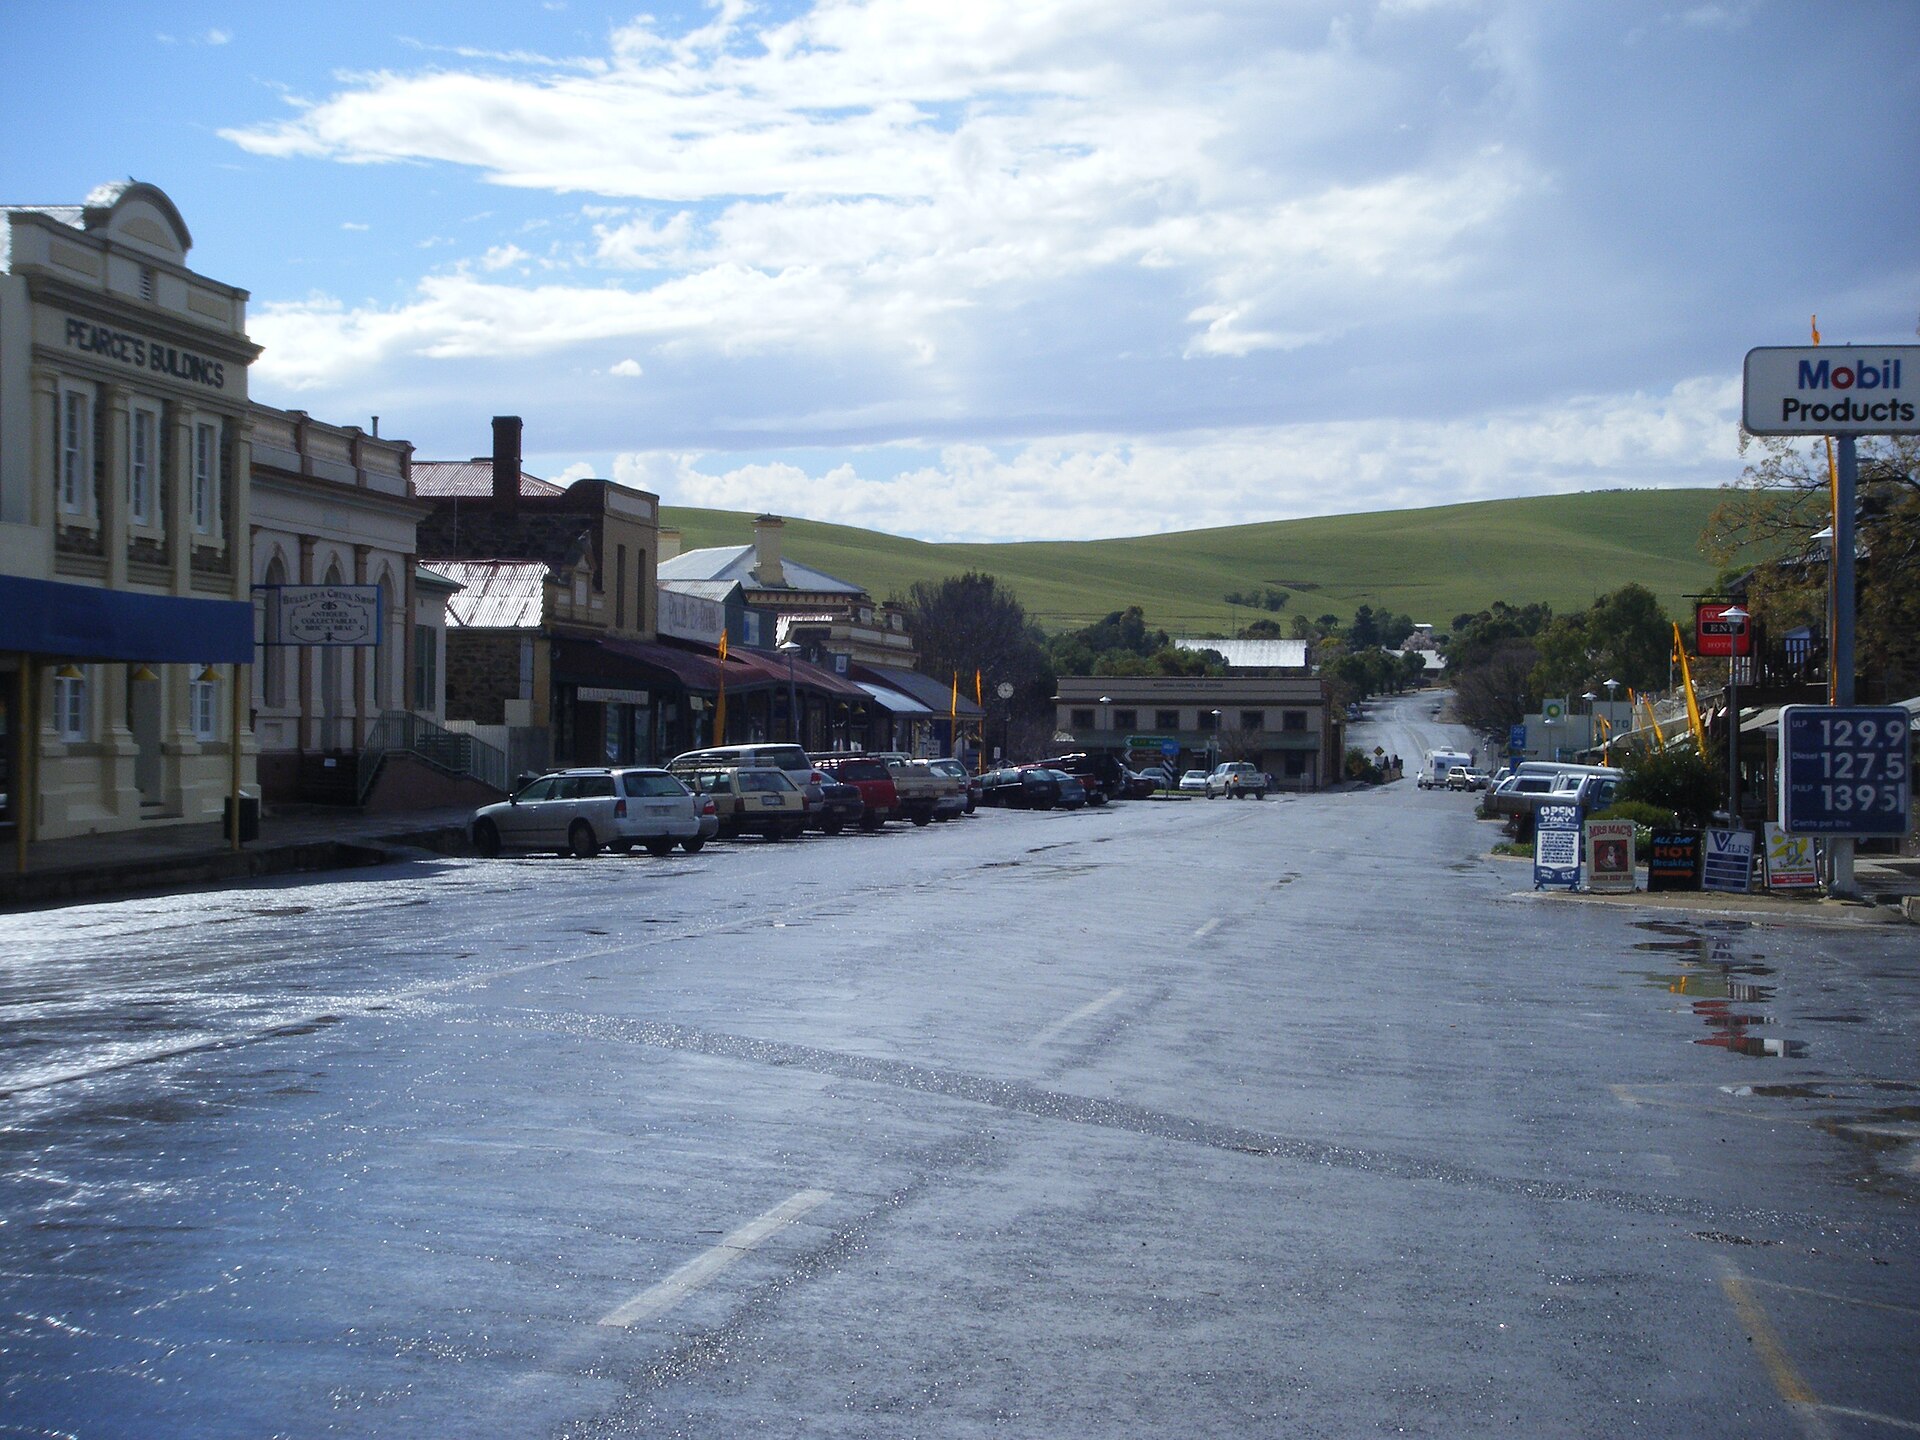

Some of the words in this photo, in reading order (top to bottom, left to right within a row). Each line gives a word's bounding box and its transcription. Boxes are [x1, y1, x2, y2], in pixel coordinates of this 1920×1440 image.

[65, 318, 146, 368] PEARCE'S
[1798, 359, 1901, 390] Mobil
[1782, 397, 1915, 422] Products
[1820, 719, 1905, 748] 129.9
[1820, 752, 1905, 780] 127.5
[1540, 806, 1577, 818] OPEN
[1653, 836, 1672, 845] ALL
[1673, 836, 1696, 844] DAY
[1654, 846, 1694, 858] HOT
[1652, 858, 1696, 868] Breakfast
